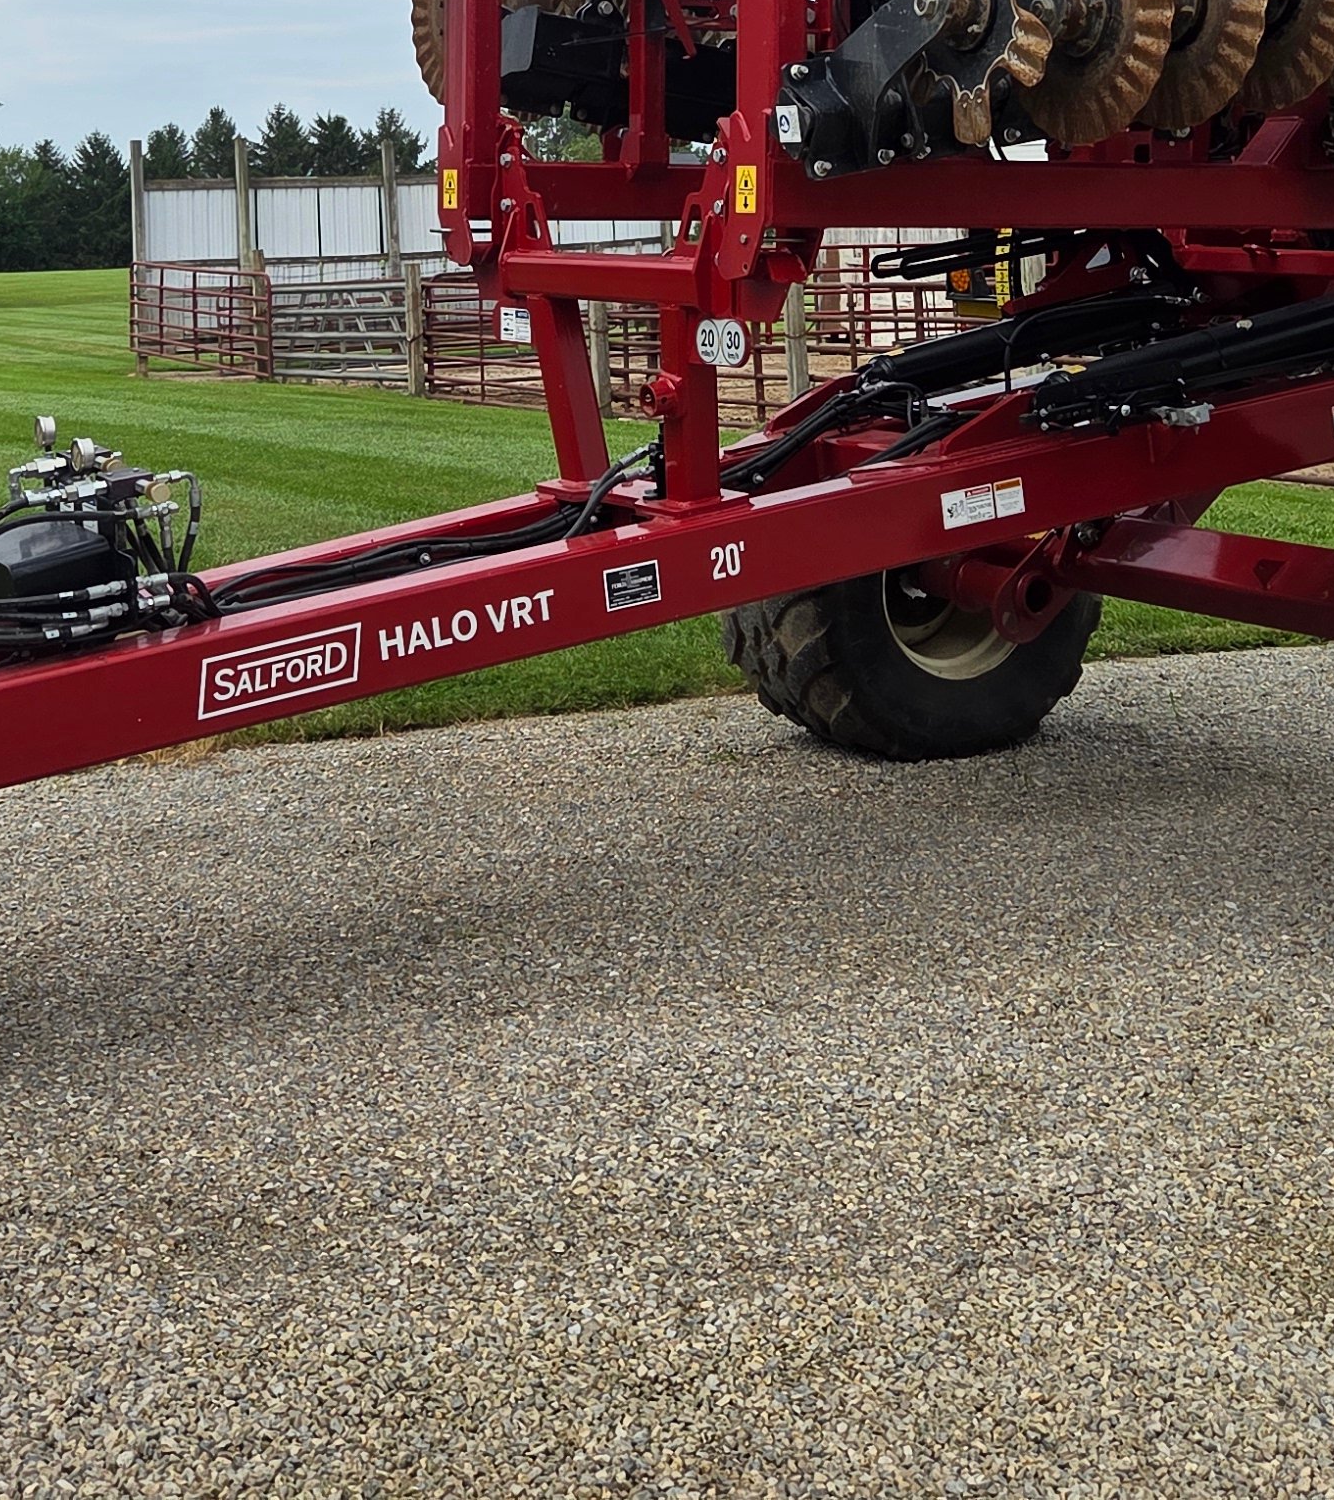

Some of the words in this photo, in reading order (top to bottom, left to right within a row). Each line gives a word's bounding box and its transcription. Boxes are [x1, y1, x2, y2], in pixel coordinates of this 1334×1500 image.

[701, 328, 715, 348] 20
[727, 330, 740, 350] 30
[711, 541, 745, 580] 20'
[213, 641, 348, 701] SALFORD
[379, 609, 478, 661] HALO
[485, 589, 554, 633] VRT
